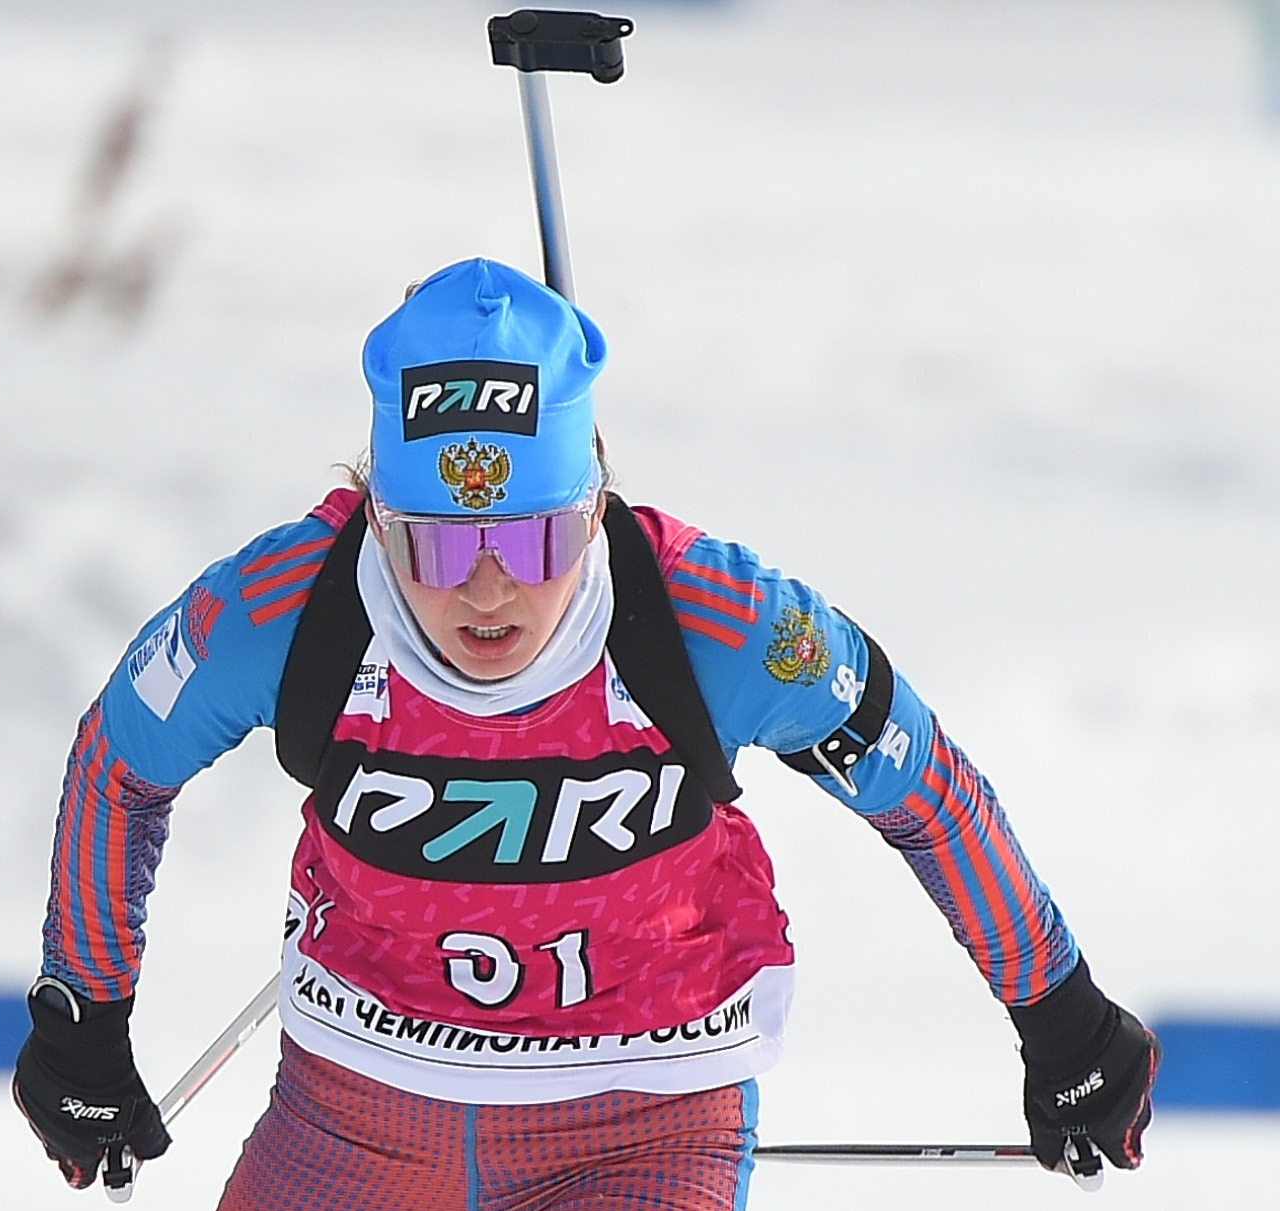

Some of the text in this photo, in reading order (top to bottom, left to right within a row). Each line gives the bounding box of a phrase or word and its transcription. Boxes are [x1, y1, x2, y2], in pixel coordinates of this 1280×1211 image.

[406, 379, 535, 421] PARI
[333, 763, 686, 864] PARI
[437, 929, 594, 1009] 31
